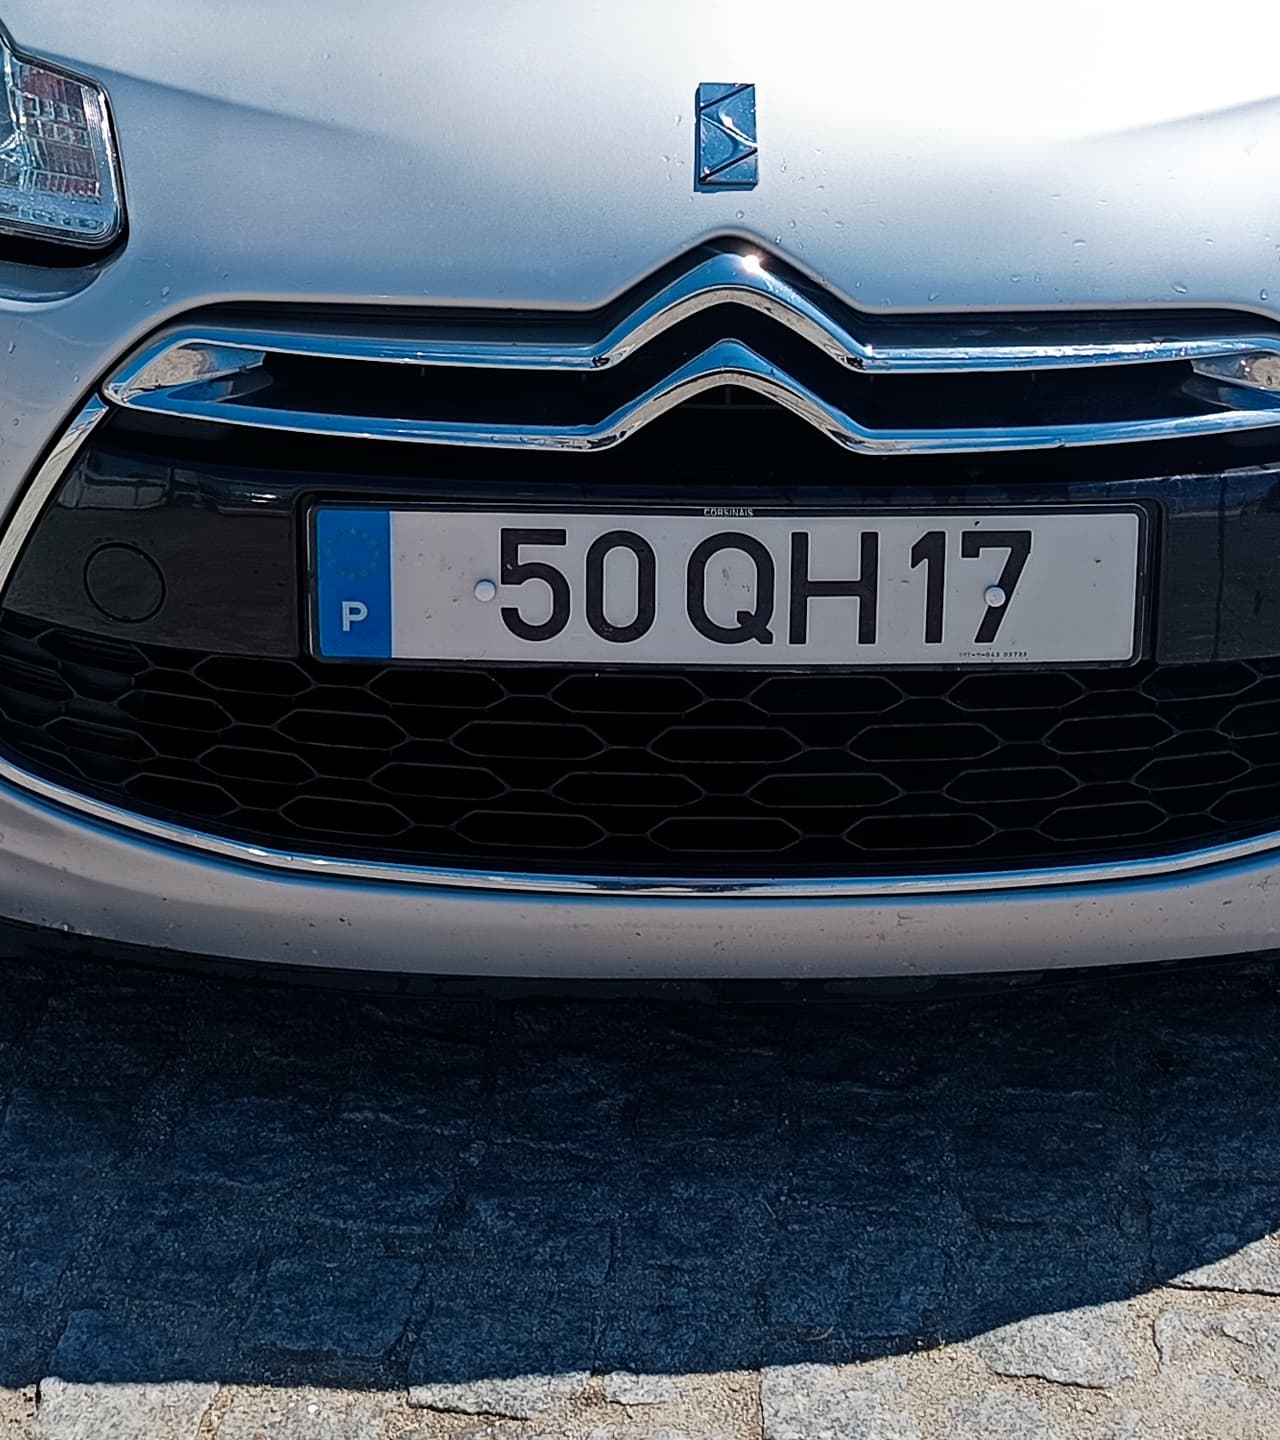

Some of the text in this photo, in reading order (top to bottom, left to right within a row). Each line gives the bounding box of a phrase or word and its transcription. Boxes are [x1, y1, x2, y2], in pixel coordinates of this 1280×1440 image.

[341, 601, 369, 632] P
[499, 527, 1033, 646] 50 QH 17
